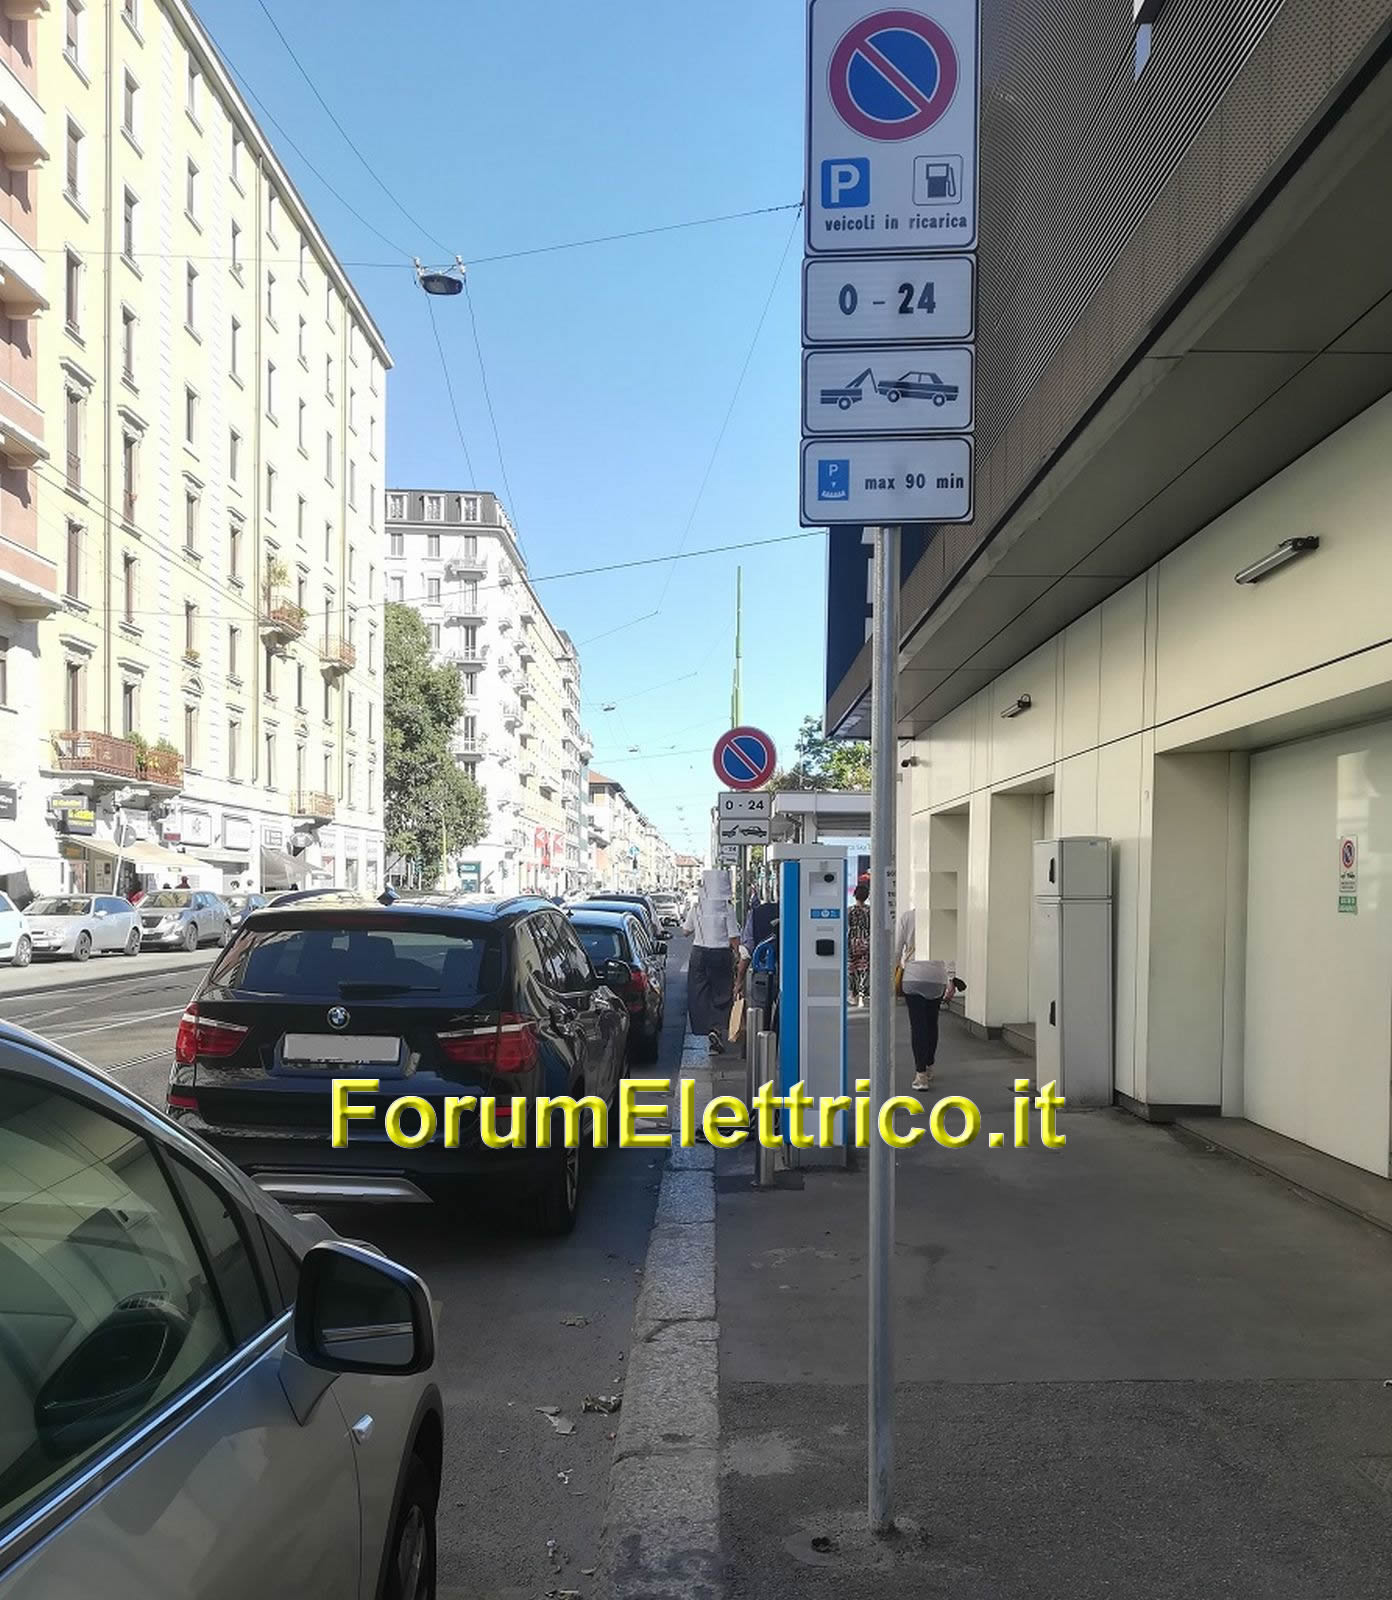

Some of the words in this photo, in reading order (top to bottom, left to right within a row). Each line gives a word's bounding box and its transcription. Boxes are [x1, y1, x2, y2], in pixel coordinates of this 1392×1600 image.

[830, 163, 861, 203] P
[825, 214, 875, 231] veicoli
[885, 214, 899, 229] in
[909, 212, 967, 229] ricarica
[839, 283, 858, 316] 0
[898, 282, 936, 314] 24
[829, 464, 839, 477] P
[865, 478, 896, 490] max
[905, 473, 926, 489] 90
[936, 473, 964, 489] min
[725, 800, 734, 810] 0
[748, 800, 764, 810] 24
